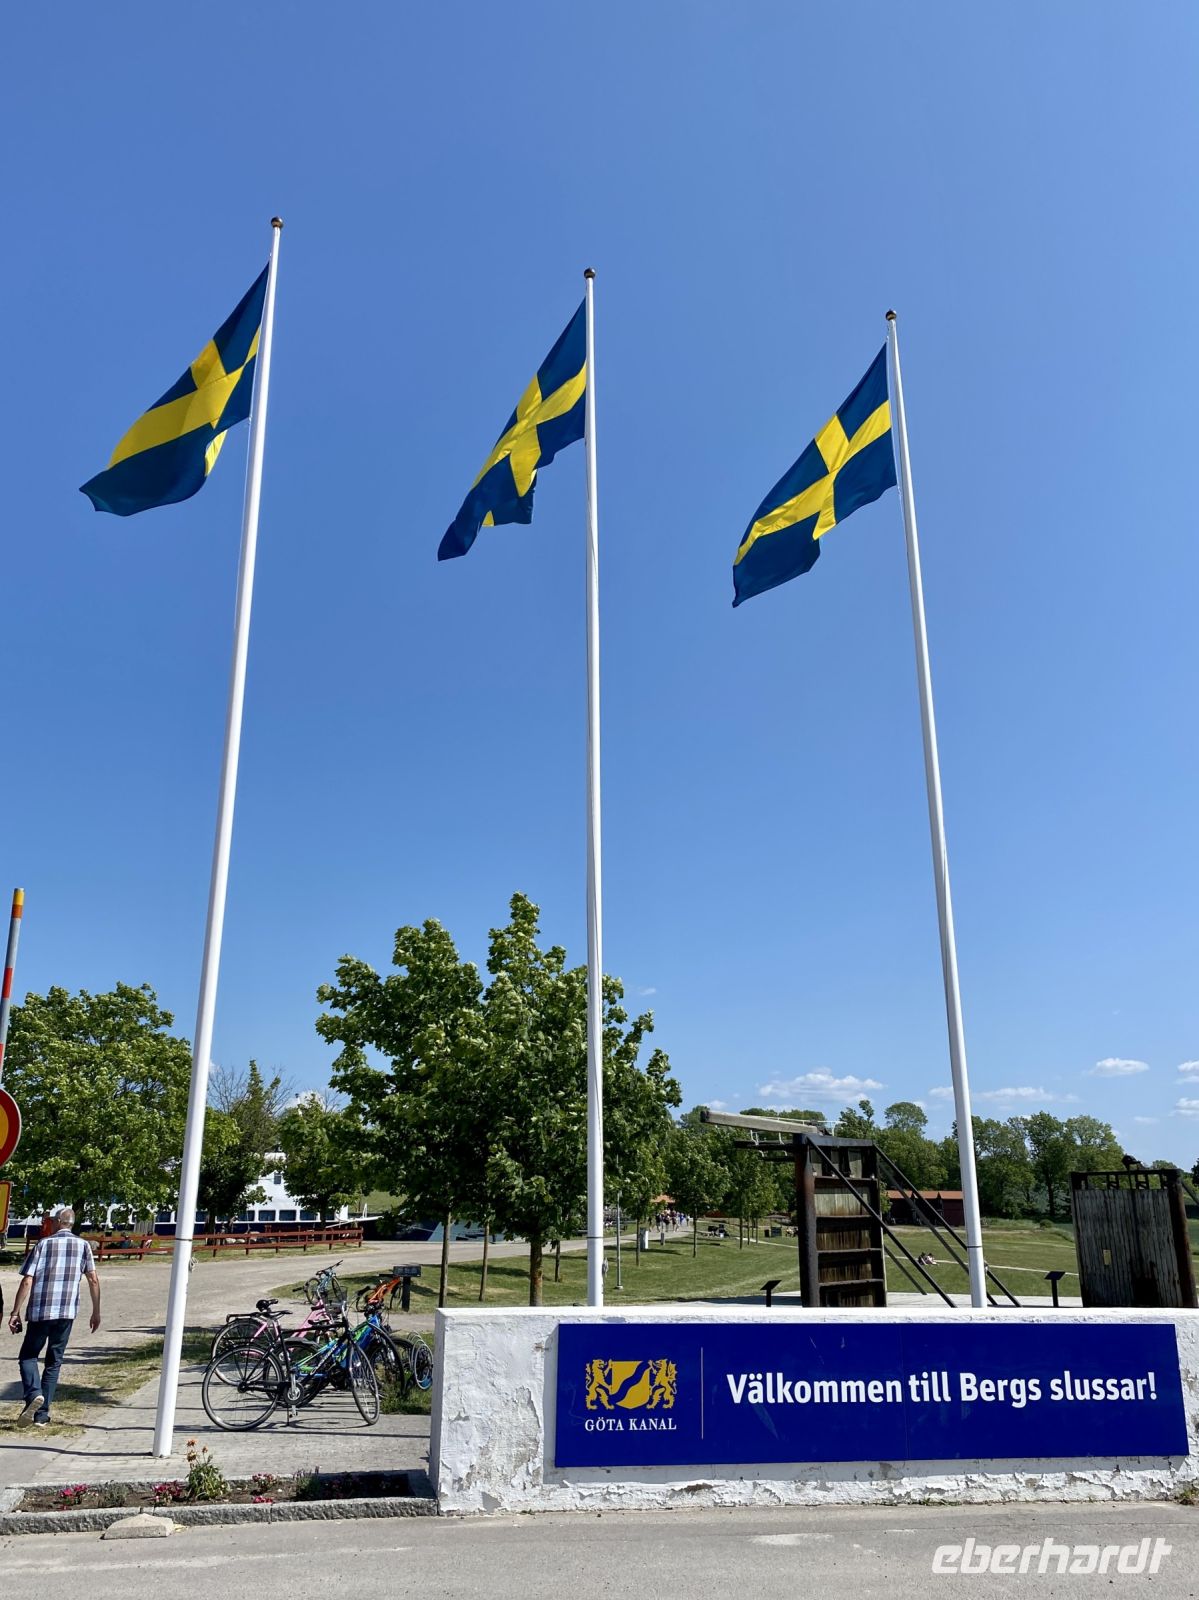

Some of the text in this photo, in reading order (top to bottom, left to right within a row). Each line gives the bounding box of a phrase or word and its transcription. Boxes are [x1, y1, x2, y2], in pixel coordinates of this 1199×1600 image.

[726, 1370, 1156, 1409] Välkommen till Bergs slussar!
[584, 1416, 677, 1432] GÖTA KANAL
